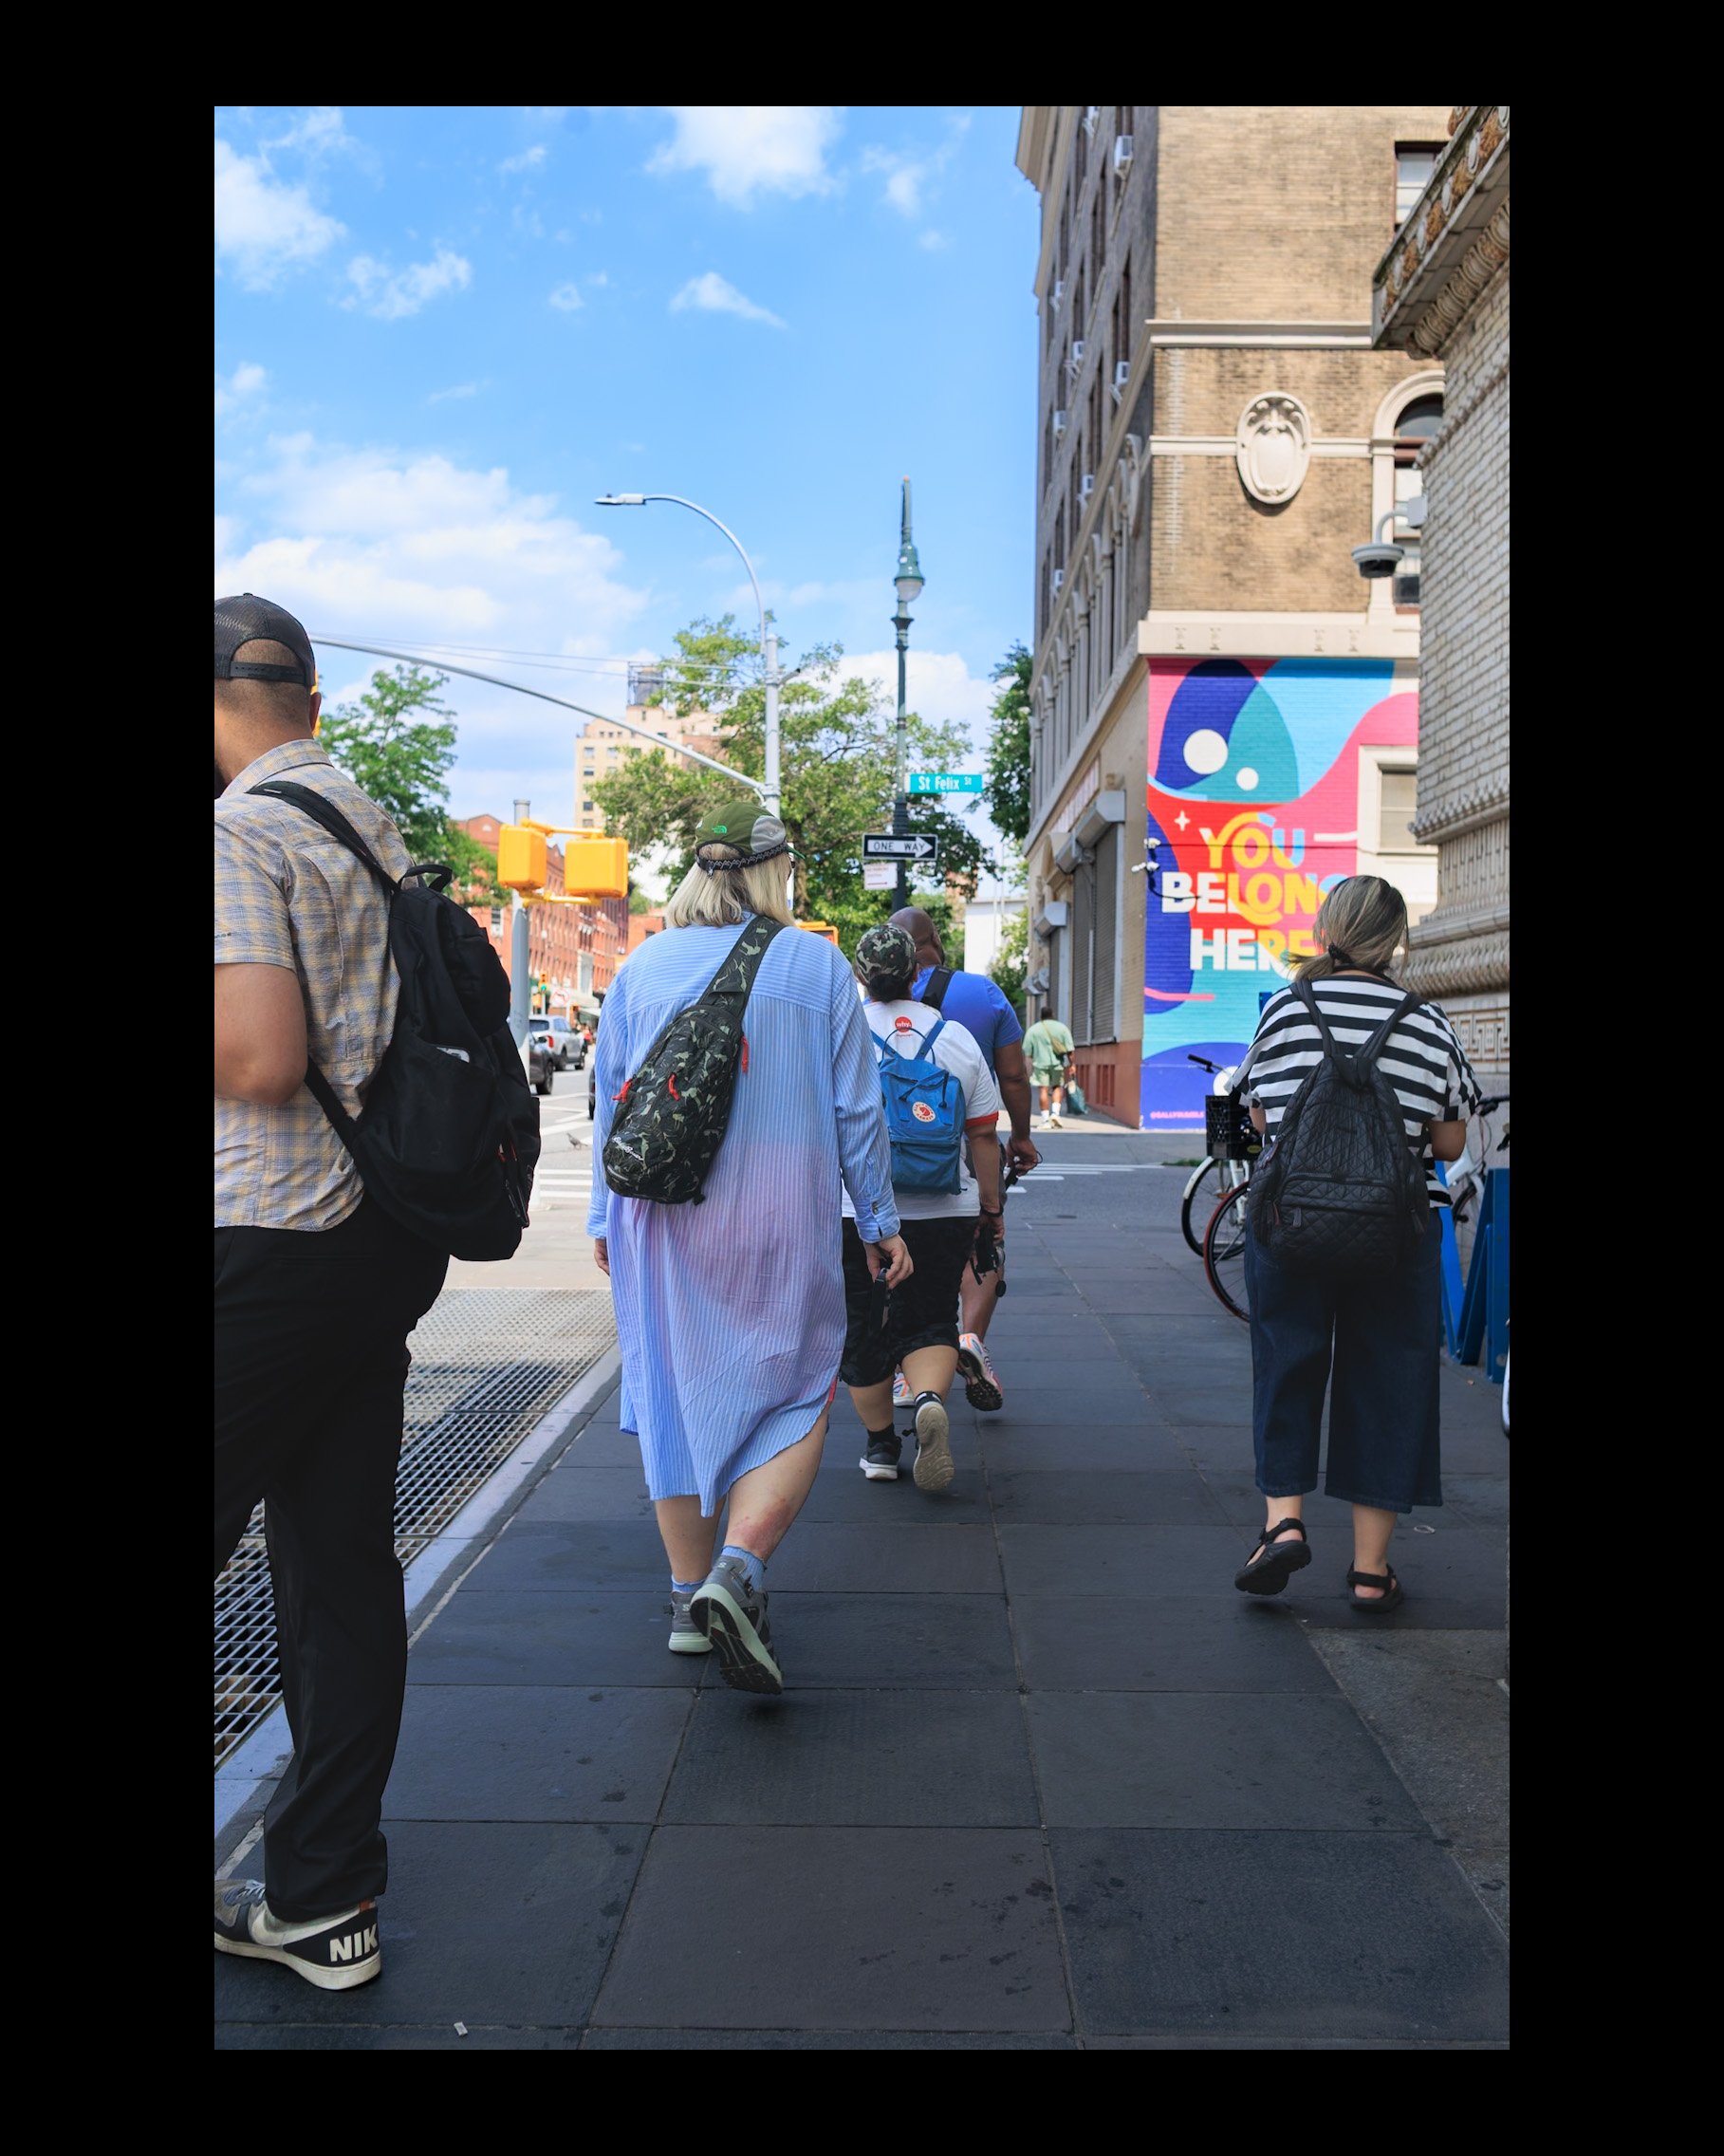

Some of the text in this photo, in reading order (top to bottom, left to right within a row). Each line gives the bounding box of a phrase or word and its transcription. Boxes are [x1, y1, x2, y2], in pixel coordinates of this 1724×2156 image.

[918, 775, 931, 790] St
[935, 775, 960, 790] Felix
[873, 841, 925, 852] ONE WAY
[1198, 811, 1306, 870] YOU
[329, 1924, 378, 1961] NIK
